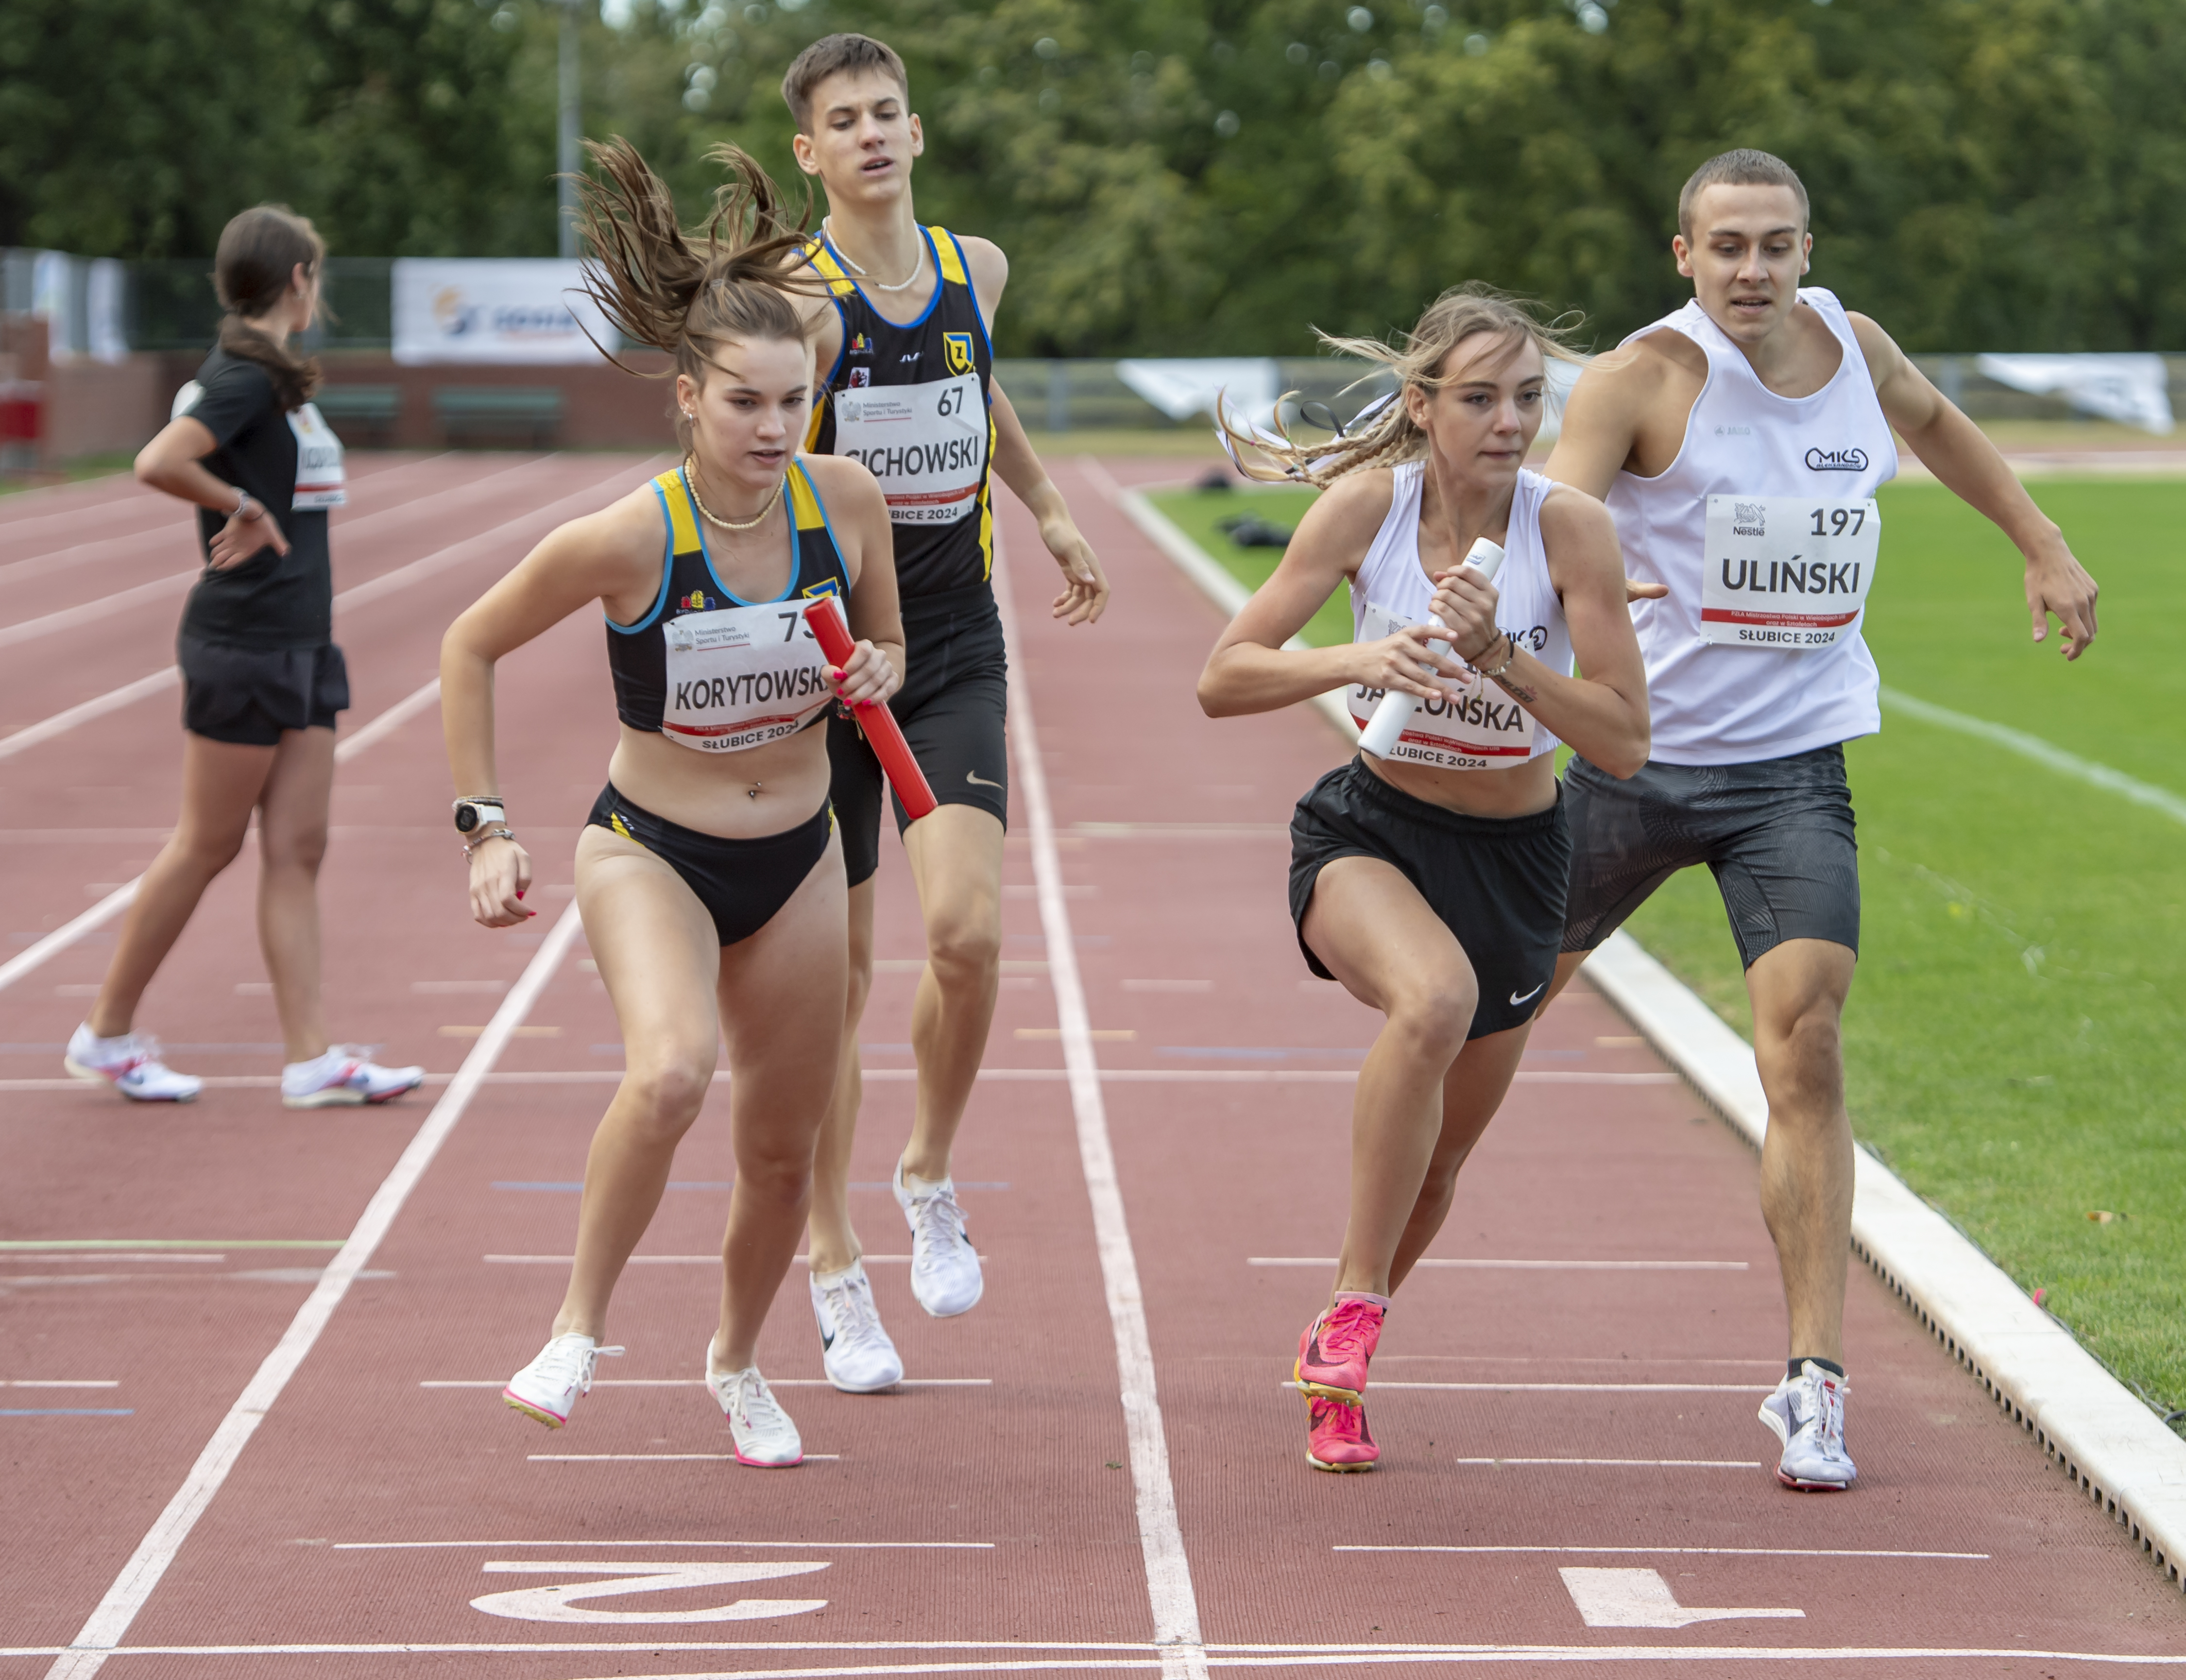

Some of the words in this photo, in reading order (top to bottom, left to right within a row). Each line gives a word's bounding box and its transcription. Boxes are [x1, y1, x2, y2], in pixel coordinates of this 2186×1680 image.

[937, 386, 963, 416] 67
[844, 435, 978, 478] ICHOWSKI
[888, 509, 923, 520] BICE
[926, 506, 957, 519] 2024
[1810, 508, 1865, 536] 197
[1722, 554, 1860, 594] ULIŃSKI
[1739, 629, 1801, 644] SŁUBICE
[1805, 632, 1835, 643] 2024
[675, 664, 828, 710] KORYTOWSK
[701, 731, 764, 749] SŁUBICE
[1447, 755, 1487, 768] 2024
